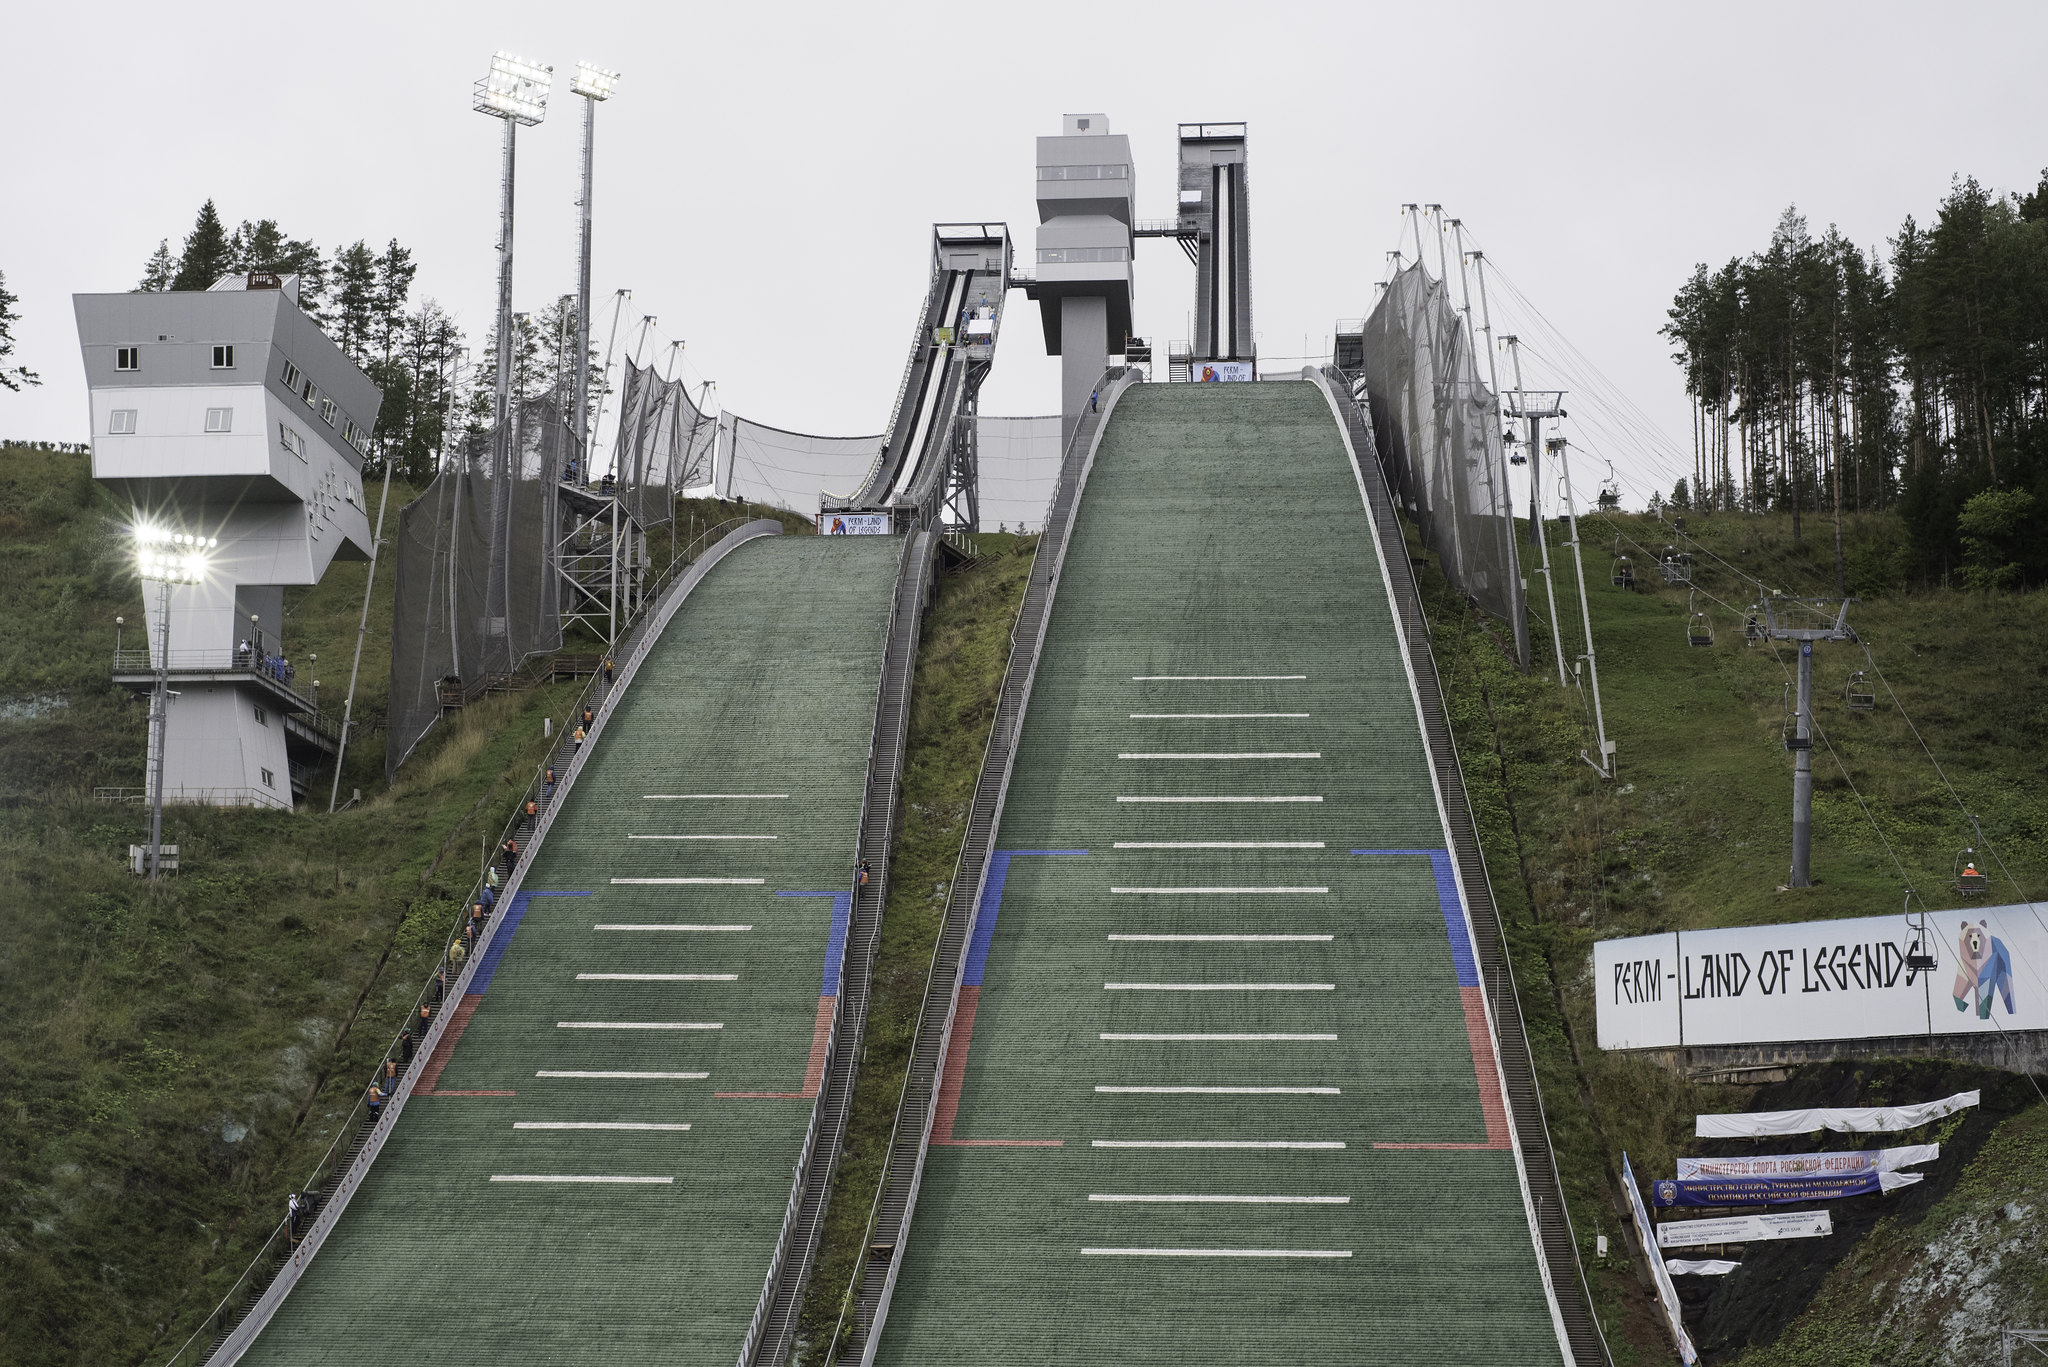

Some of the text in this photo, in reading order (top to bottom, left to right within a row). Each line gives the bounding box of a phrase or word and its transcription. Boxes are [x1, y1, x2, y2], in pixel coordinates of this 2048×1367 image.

[848, 517, 863, 525] PERM
[868, 517, 881, 525] LAND
[849, 526, 856, 534] OF
[1614, 958, 1661, 1005] PERM
[1684, 952, 1751, 999] LAND
[1757, 949, 1793, 995] OF
[1700, 1156, 1865, 1176] МИНИСТЕРСТВО СПОРТА РОССИЙСКОЙ ФЕДЕРАЦИИ
[1749, 1191, 1799, 1200] РОССИЙСКОЙ
[1800, 1190, 1842, 1198] ФЕДЕРАЦИИ
